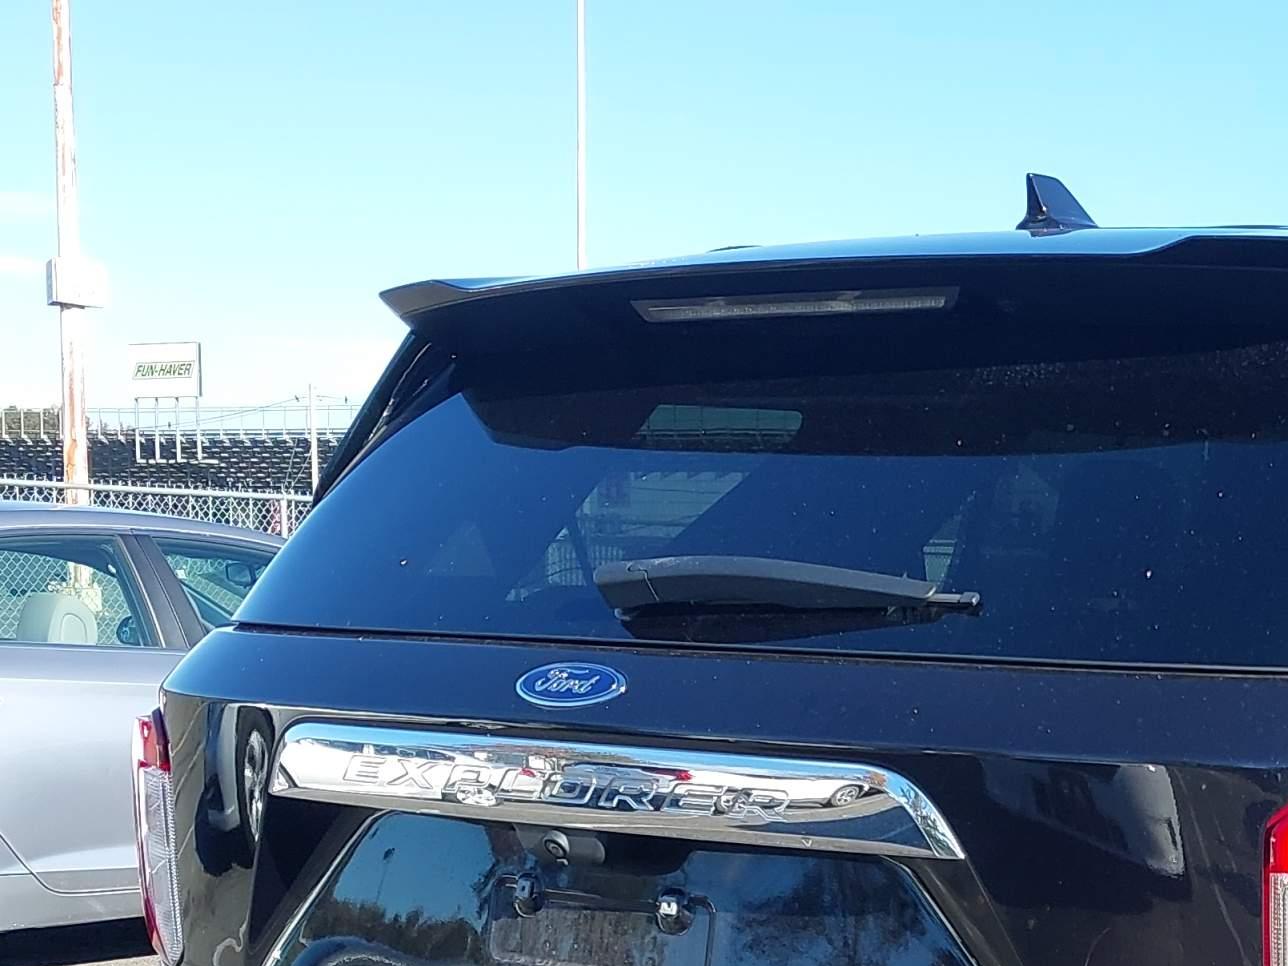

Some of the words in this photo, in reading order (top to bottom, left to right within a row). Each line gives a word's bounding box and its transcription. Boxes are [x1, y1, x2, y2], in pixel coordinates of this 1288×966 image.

[135, 363, 192, 377] FUN-HAVER
[534, 668, 601, 694] Ford
[343, 753, 792, 823] EXPLORER
